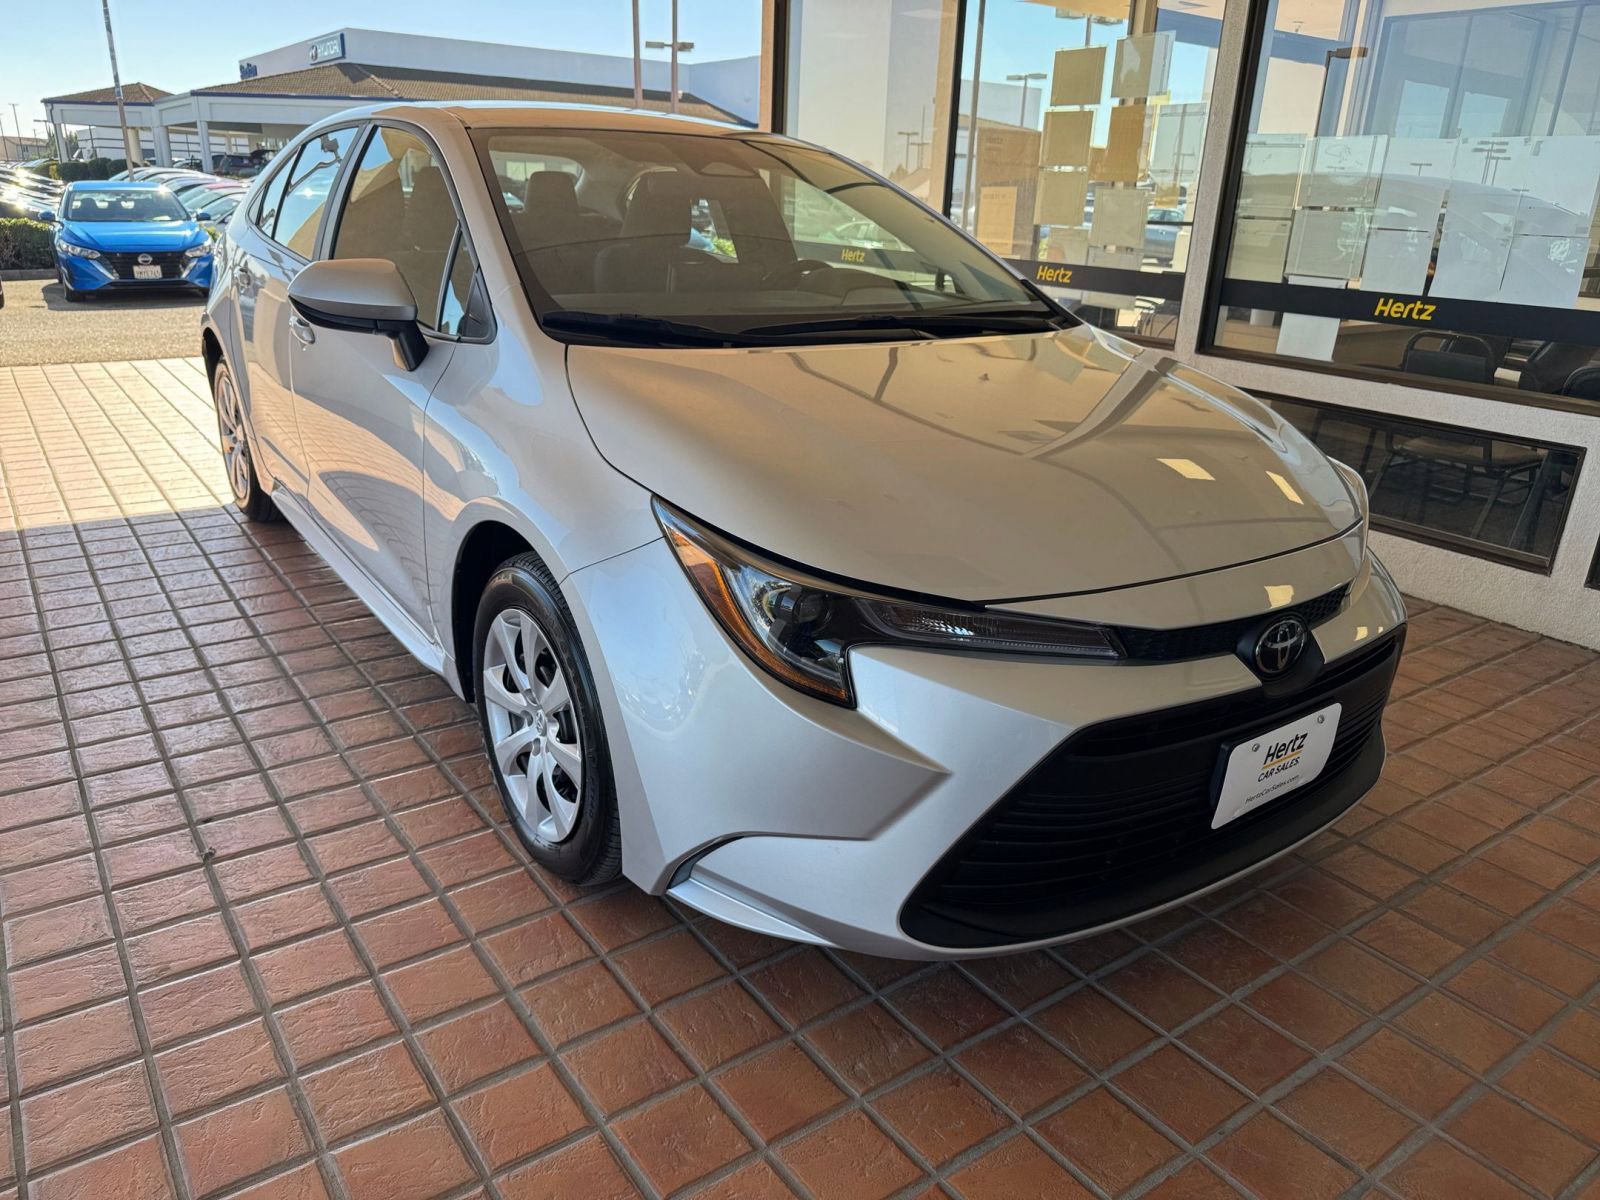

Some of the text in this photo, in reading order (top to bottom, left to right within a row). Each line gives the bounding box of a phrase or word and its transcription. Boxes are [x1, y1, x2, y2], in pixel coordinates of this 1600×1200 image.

[841, 248, 865, 262] Hertz
[1036, 265, 1072, 283] Hertz
[1374, 297, 1436, 321] Hertz
[1263, 732, 1308, 765] Hertz
[1257, 756, 1300, 783] CAR SALES
